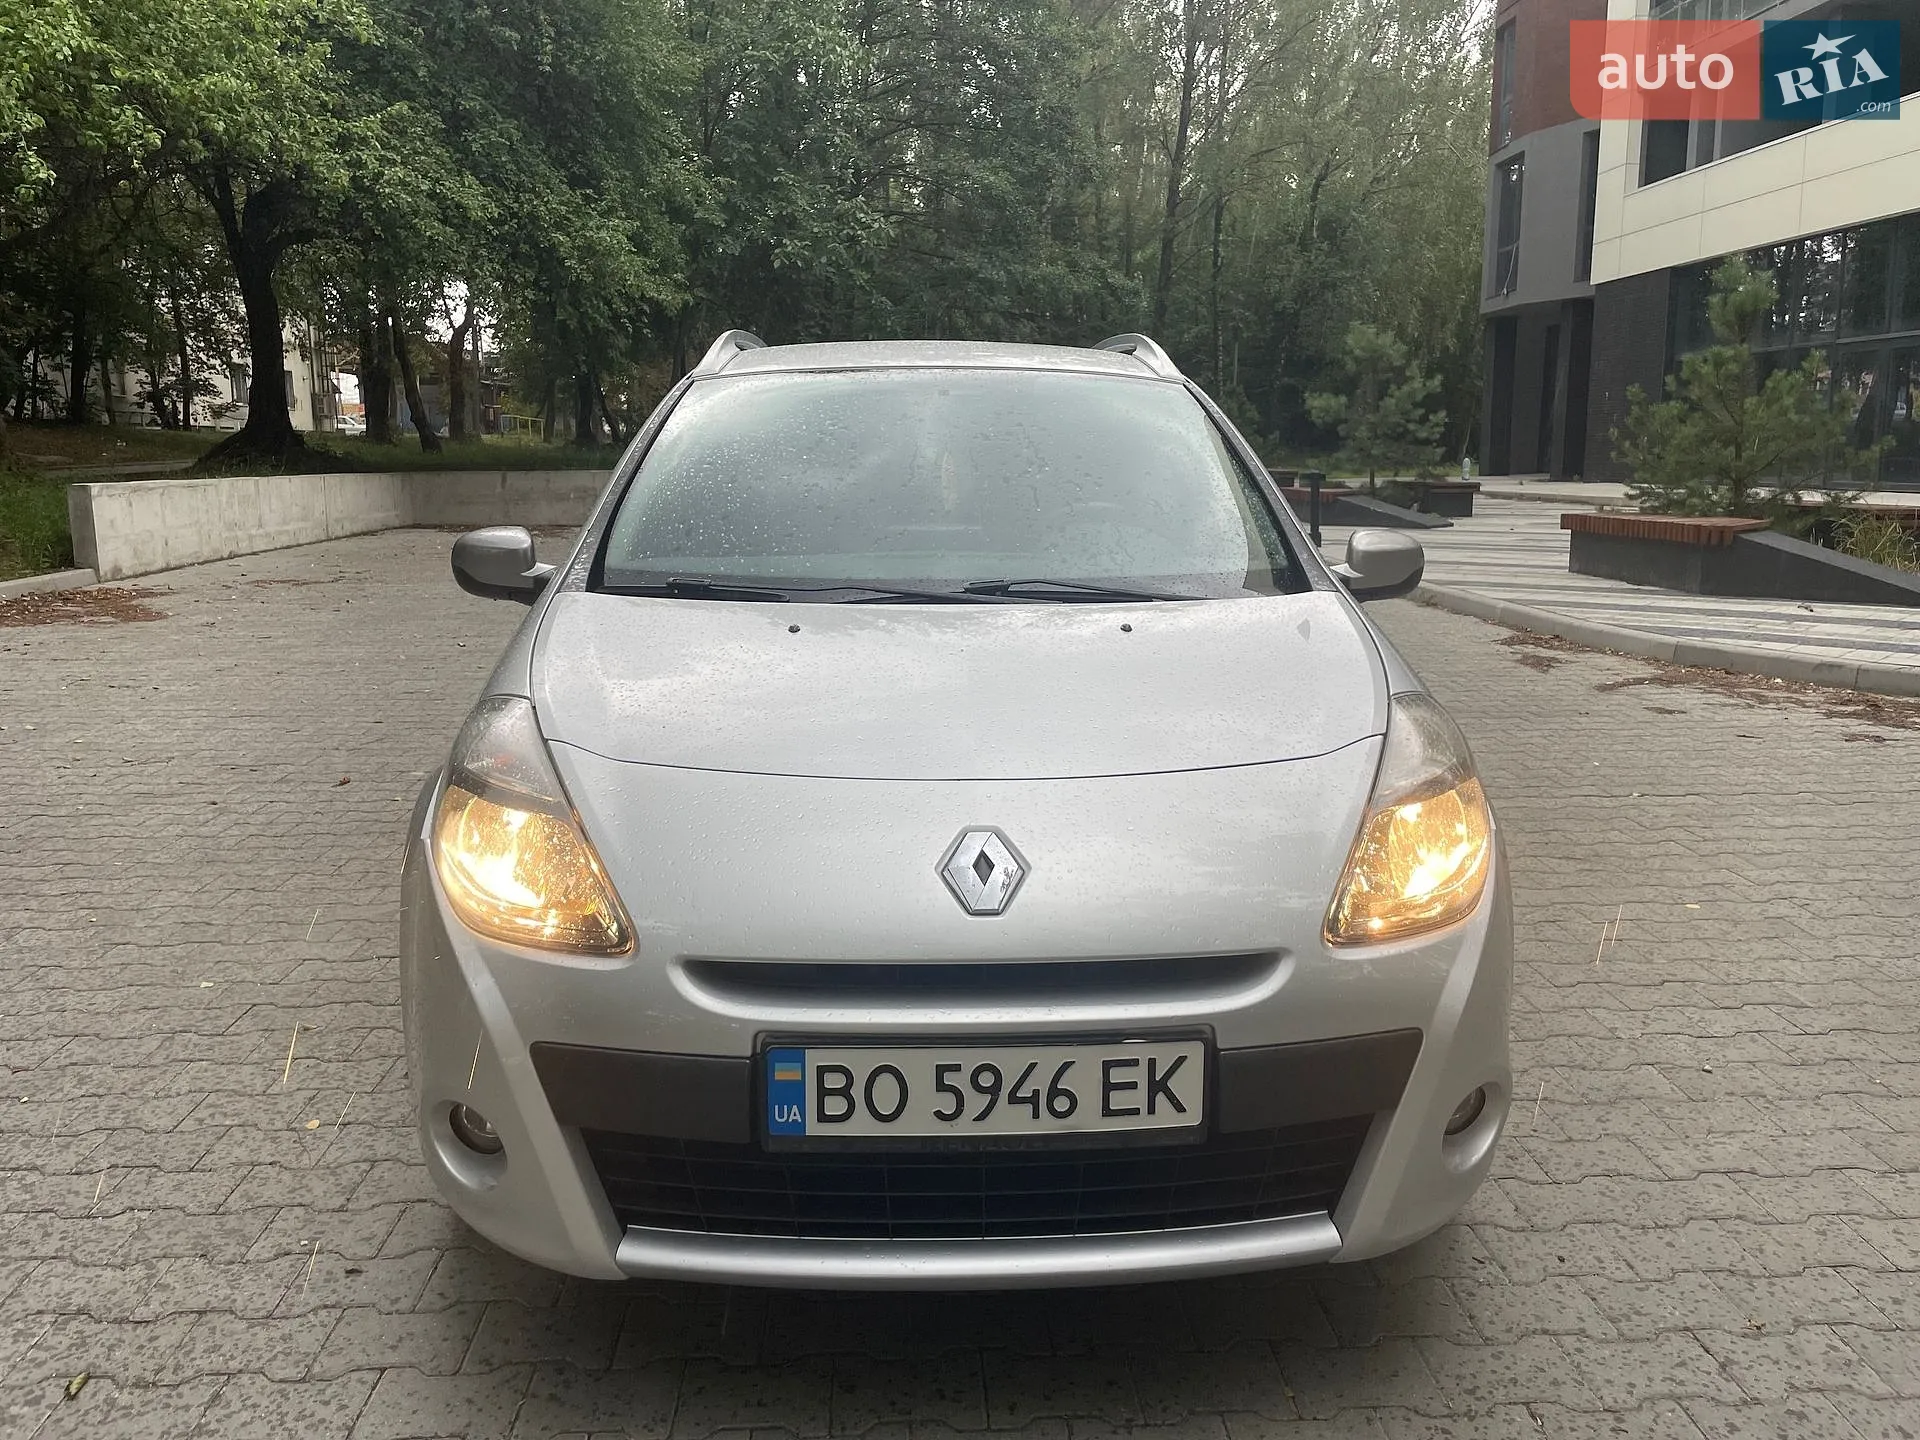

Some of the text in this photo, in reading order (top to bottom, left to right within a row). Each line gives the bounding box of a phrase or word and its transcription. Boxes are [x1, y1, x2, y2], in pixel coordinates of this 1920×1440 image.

[816, 1055, 1188, 1124] BO 5946 EK
[775, 1105, 802, 1123] UA
